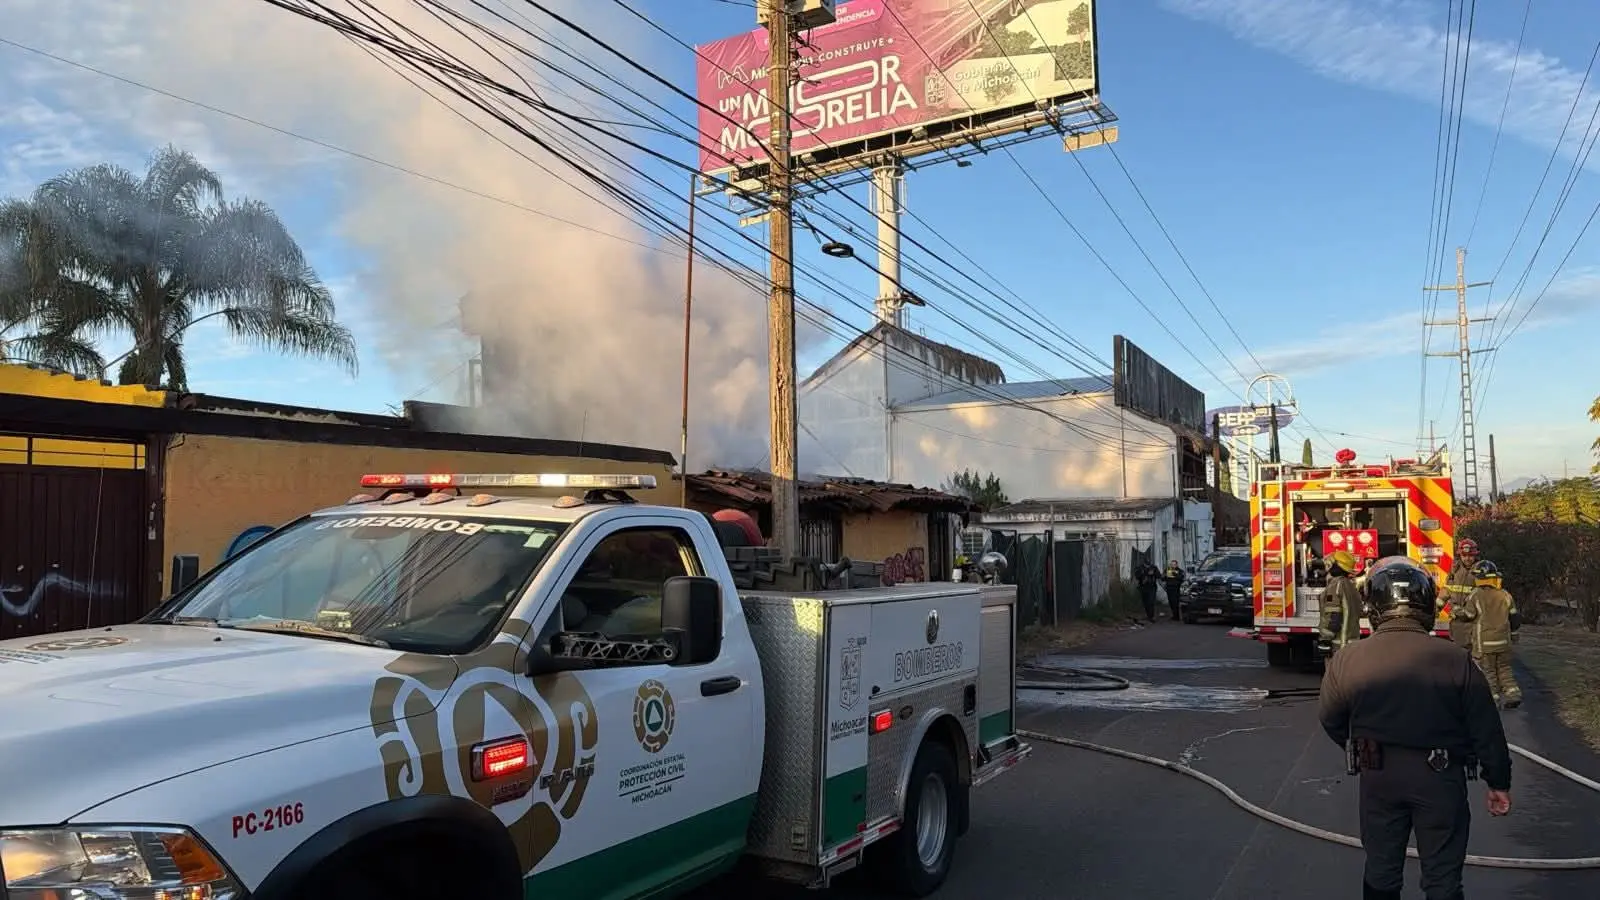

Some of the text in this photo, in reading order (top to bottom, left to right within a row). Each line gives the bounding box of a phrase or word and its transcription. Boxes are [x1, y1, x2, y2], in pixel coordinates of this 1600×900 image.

[818, 37, 885, 63] CONSTRUYE
[719, 95, 741, 113] UN
[893, 641, 964, 683] BOMBEROS
[667, 762, 686, 775] CIVIL
[231, 801, 305, 839] PC-2166
